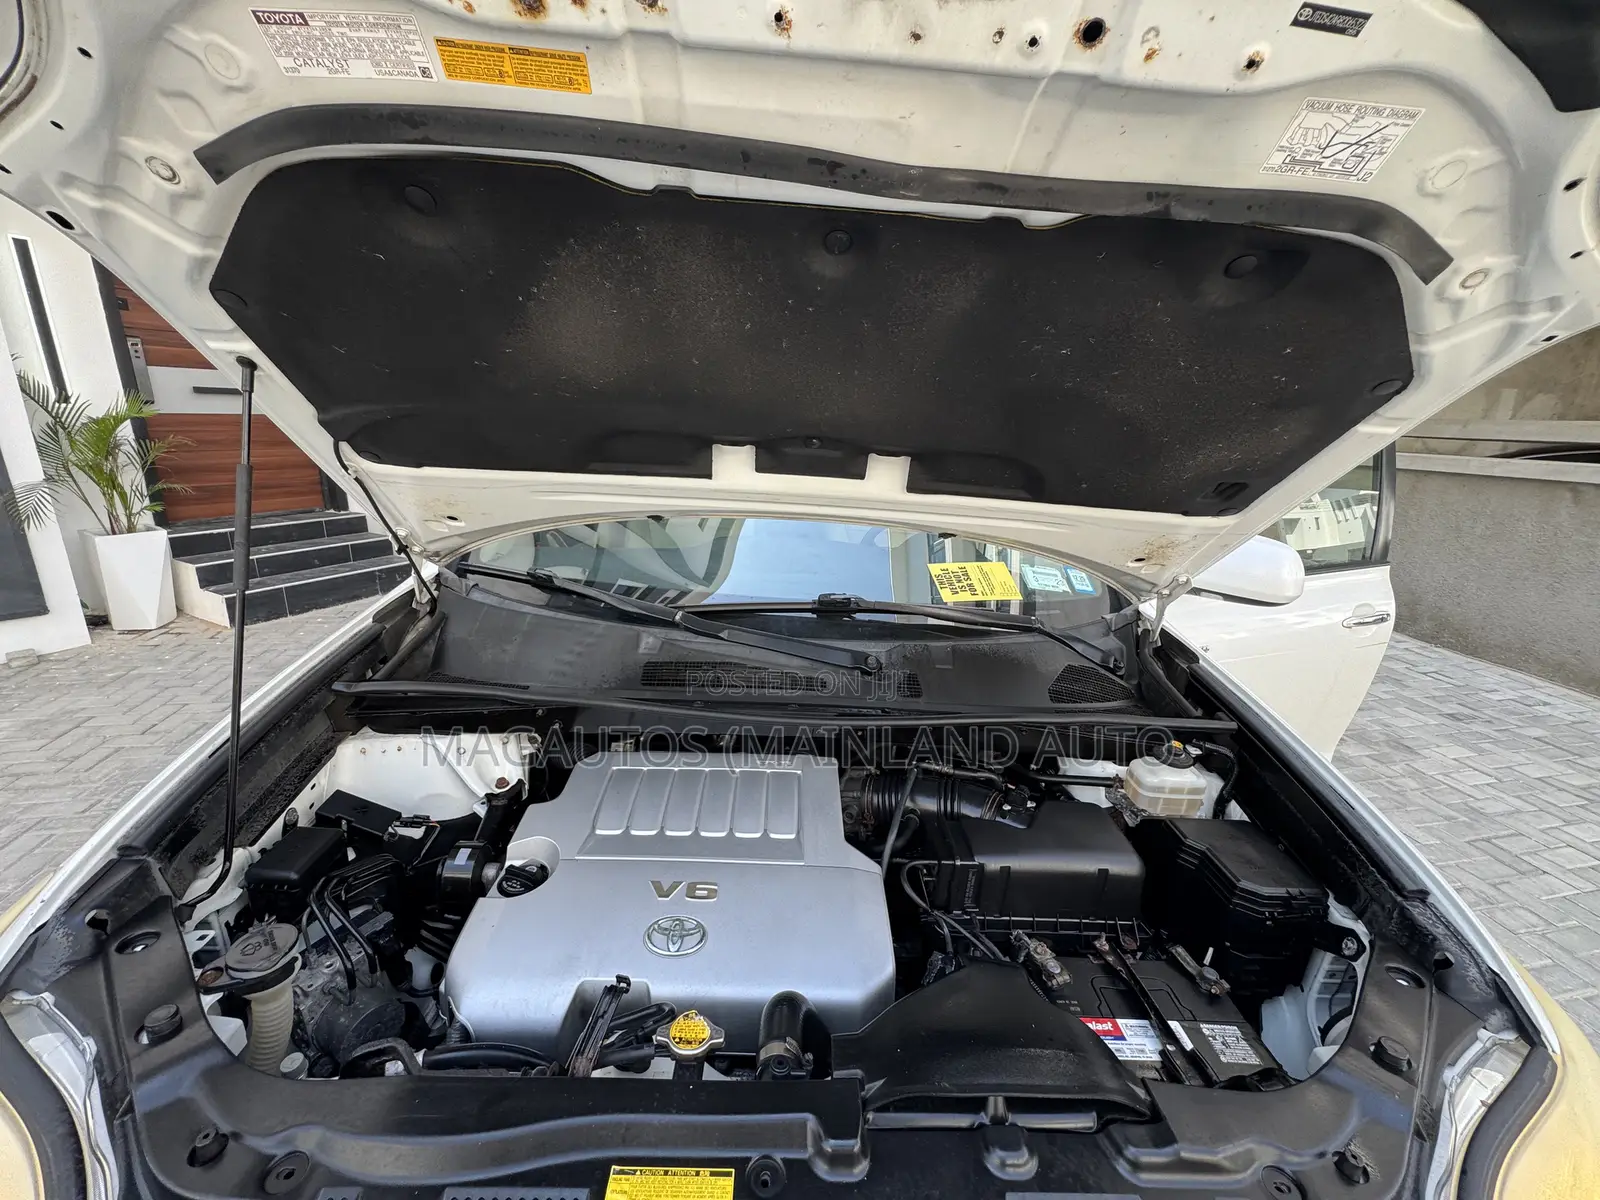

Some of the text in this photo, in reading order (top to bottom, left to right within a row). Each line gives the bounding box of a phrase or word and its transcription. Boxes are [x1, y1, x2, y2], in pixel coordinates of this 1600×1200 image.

[256, 12, 305, 25] TOYOTA
[305, 13, 341, 21] IMPORTANT
[372, 16, 413, 24] INFORMATION
[293, 58, 350, 69] CATALYST
[1304, 101, 1420, 119] VACUUM HOSE ROUTING DIAGRAM
[1274, 166, 1309, 176] 2GR-FE
[1356, 171, 1374, 183] J2
[935, 574, 948, 590] THIS
[940, 567, 960, 596] VEHICLE
[951, 570, 969, 592] IS NOT
[957, 565, 979, 596] FOR SALE
[649, 880, 718, 901] V6
